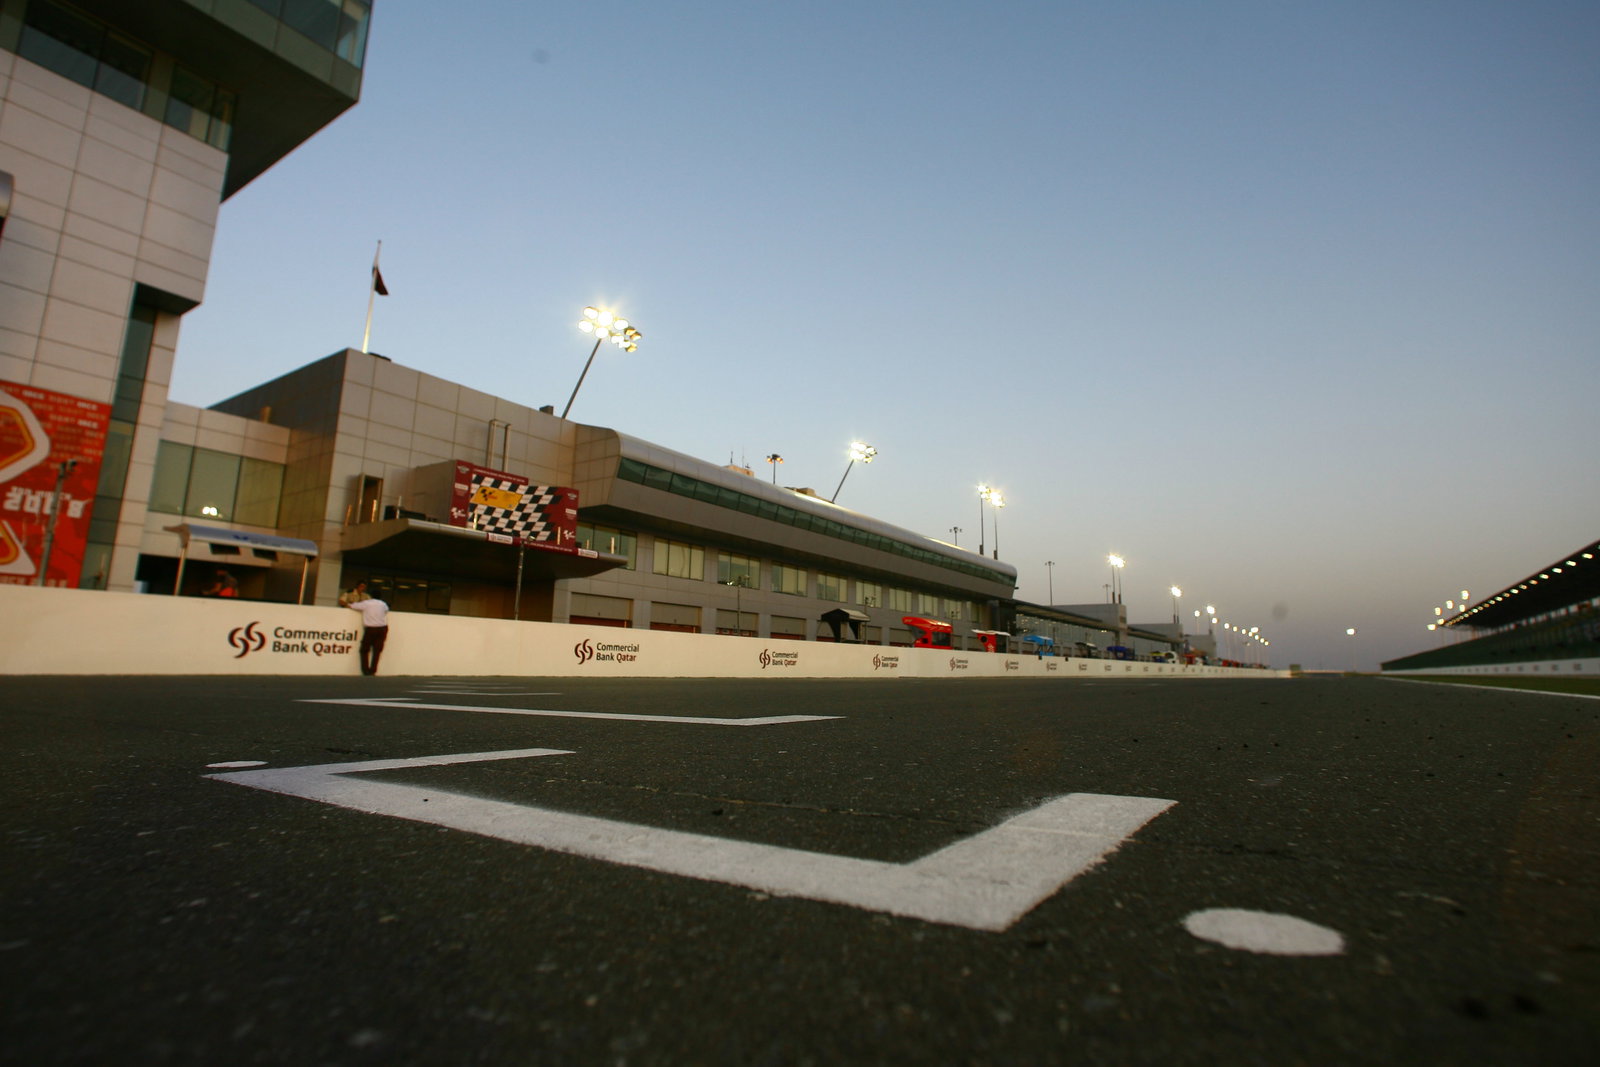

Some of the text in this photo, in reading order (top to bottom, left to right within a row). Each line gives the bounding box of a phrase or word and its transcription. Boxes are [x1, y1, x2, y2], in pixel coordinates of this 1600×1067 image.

[273, 626, 358, 641] Commercial
[272, 641, 352, 656] Bank Qatar
[596, 642, 640, 652] Commercial
[596, 652, 637, 663] Bank Qatar
[772, 651, 799, 659] Commercial
[784, 659, 797, 668] Qatar
